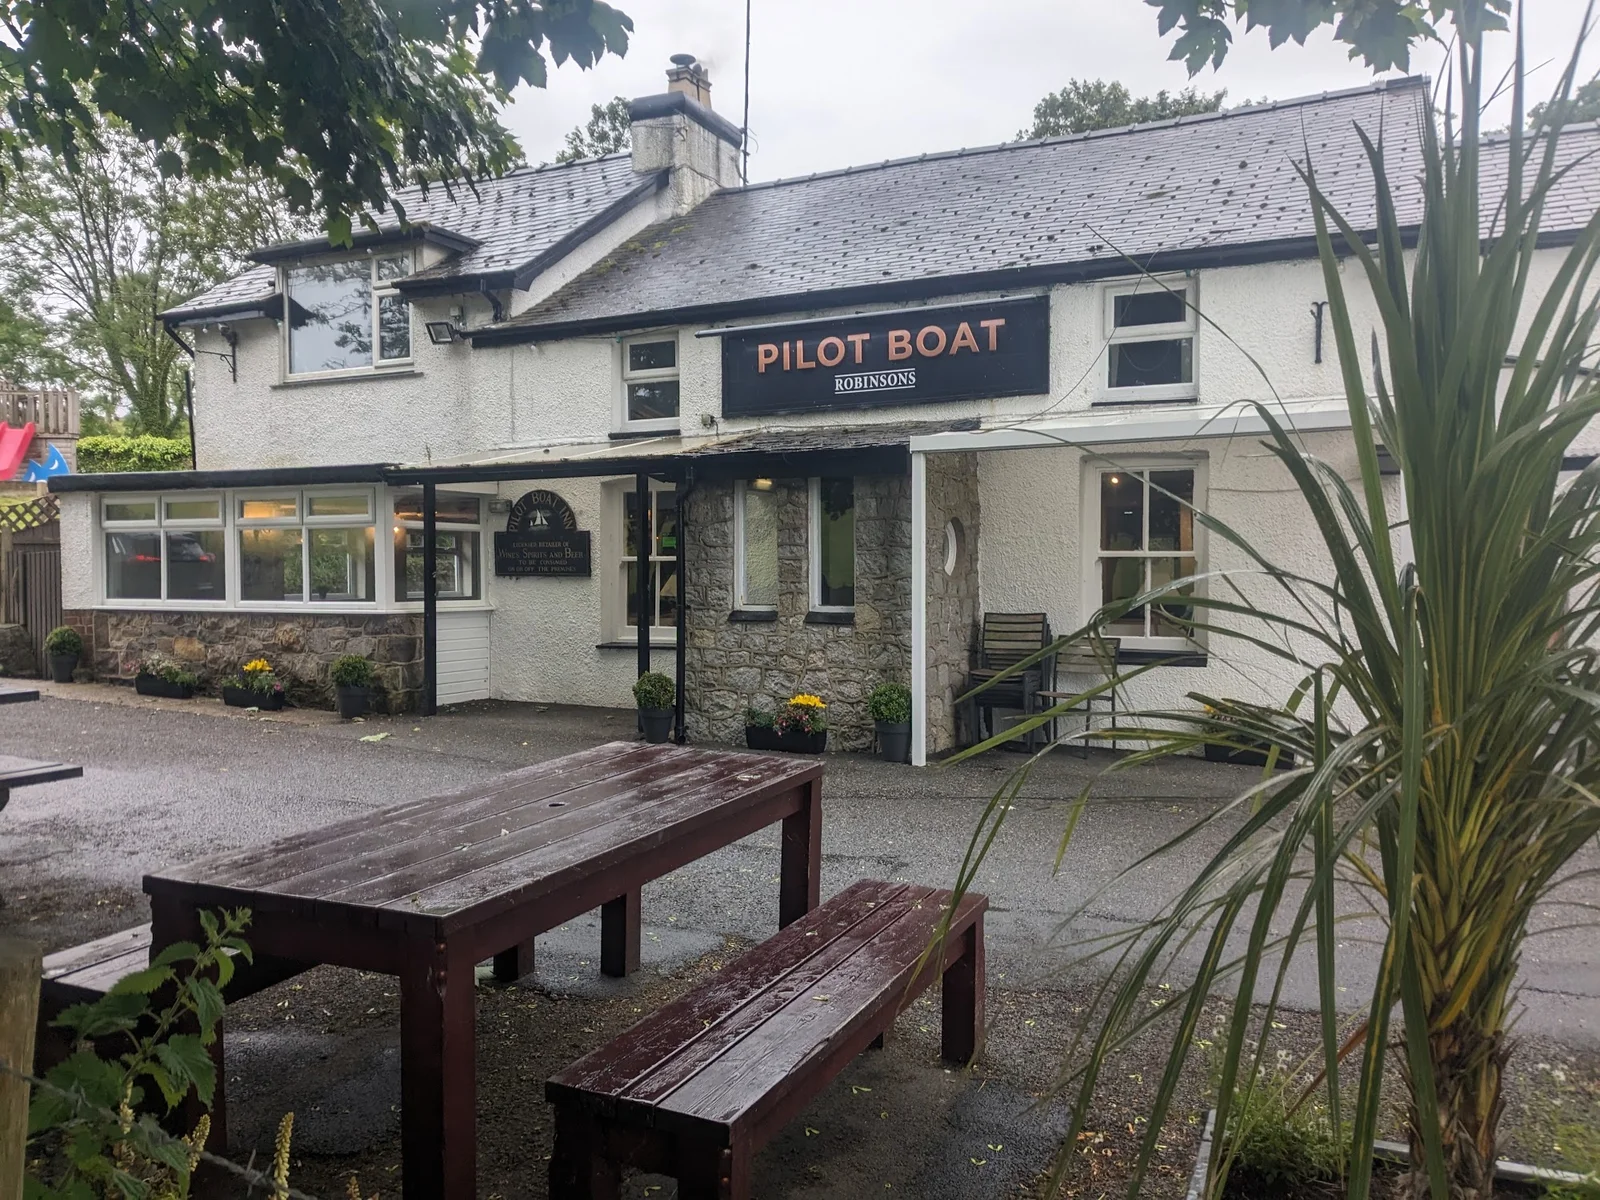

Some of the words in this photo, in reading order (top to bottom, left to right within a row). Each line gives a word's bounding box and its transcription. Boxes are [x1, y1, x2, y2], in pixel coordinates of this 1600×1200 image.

[758, 333, 870, 373] PILOT
[888, 318, 1005, 360] BOAT
[835, 371, 916, 391] ROBINSONS
[509, 498, 527, 532] PILOT
[531, 491, 559, 508] BOAT
[559, 506, 574, 530] INN
[522, 547, 547, 559] SPIRITS
[549, 551, 563, 559] AND
